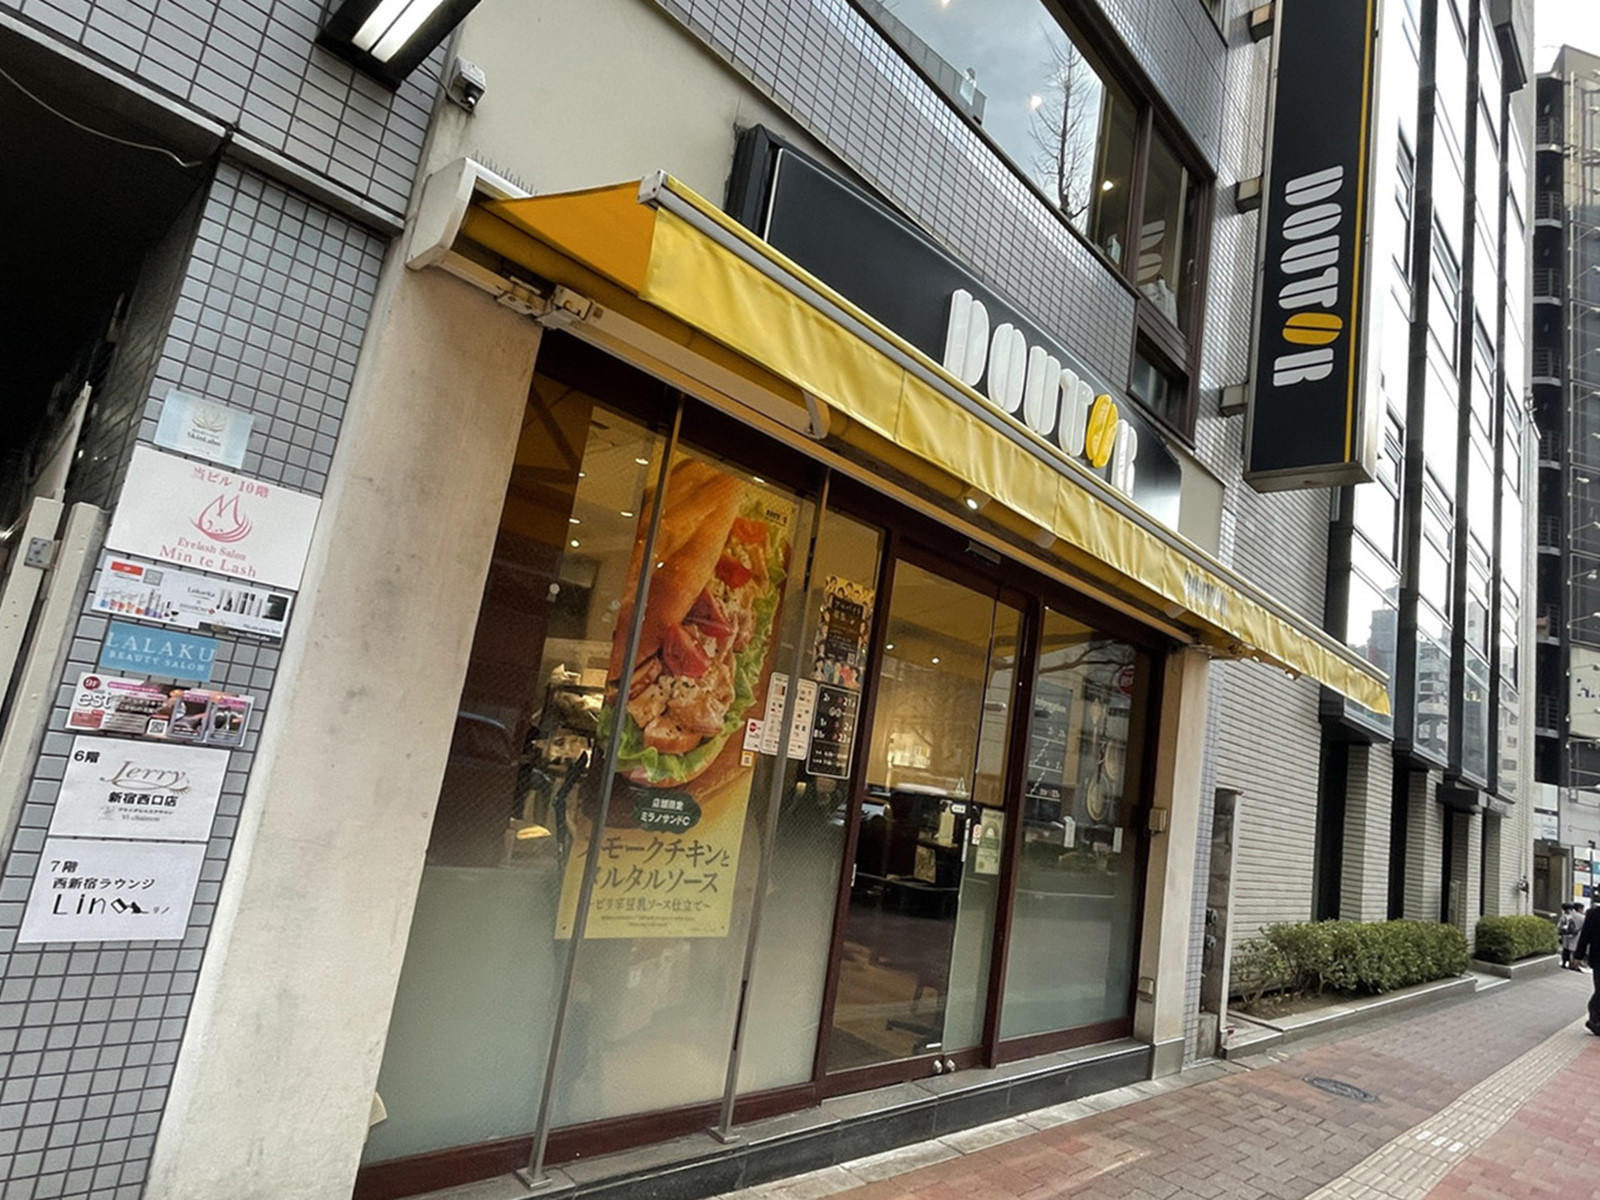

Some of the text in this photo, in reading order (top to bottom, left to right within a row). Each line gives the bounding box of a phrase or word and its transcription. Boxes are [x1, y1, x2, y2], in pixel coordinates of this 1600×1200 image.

[1273, 165, 1344, 387] DOUTOR
[943, 289, 1138, 499] DOUTOR
[177, 537, 247, 561] Eyelash Salon
[159, 545, 257, 578] Min te Lash
[106, 632, 217, 662] LALAKU
[109, 650, 206, 672] BEAUTY SALON
[73, 750, 101, 764] 6階
[108, 791, 179, 807] 新宿西口店
[50, 860, 79, 873] 7階
[52, 877, 156, 890] 西新宿ラウンジ
